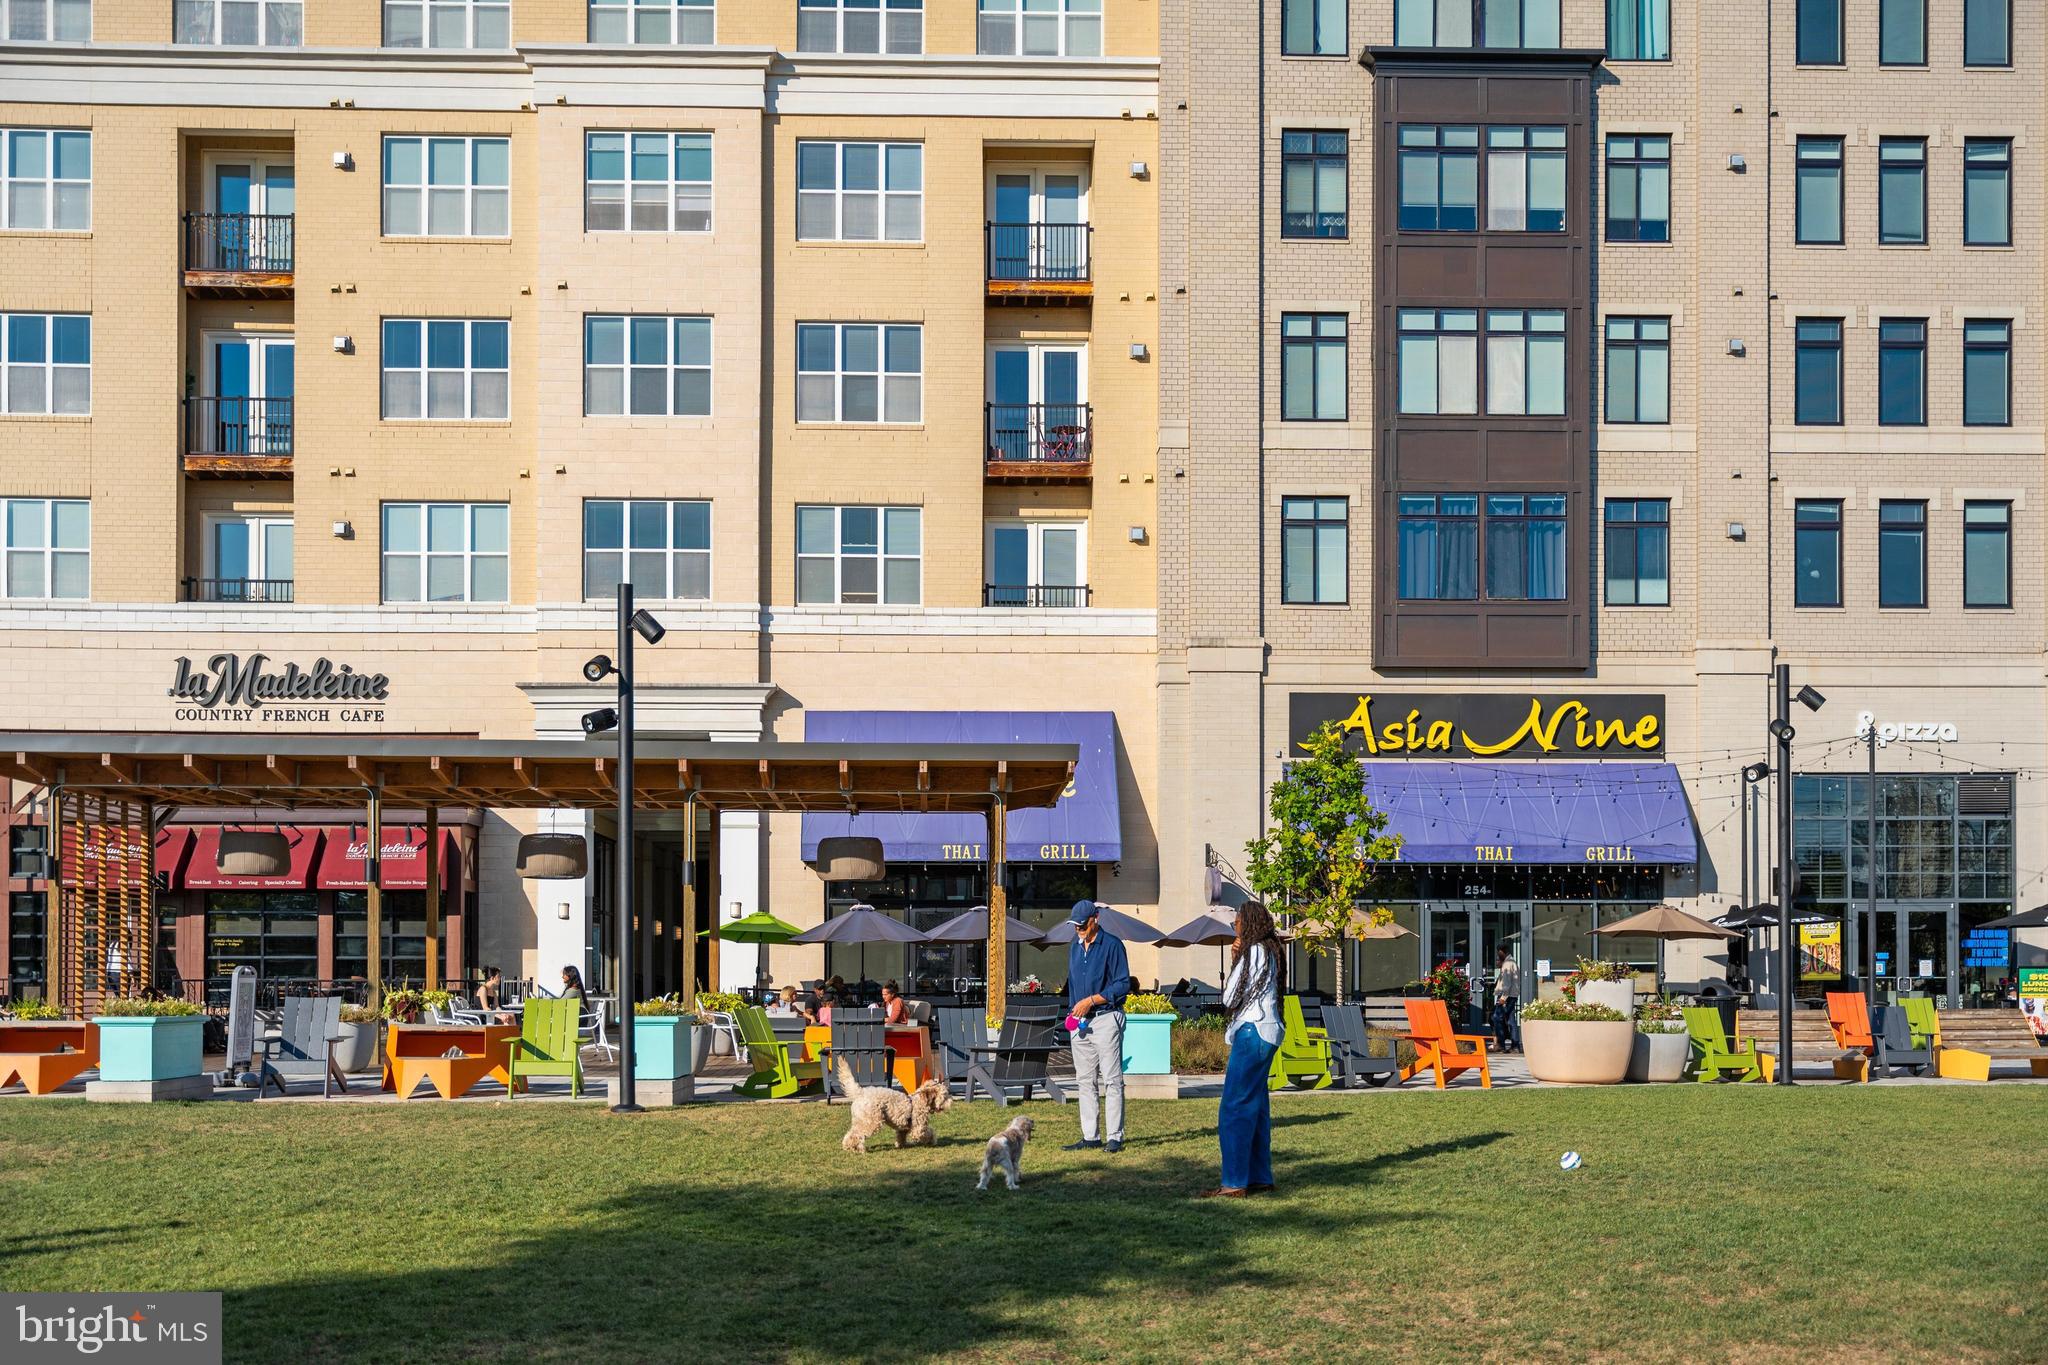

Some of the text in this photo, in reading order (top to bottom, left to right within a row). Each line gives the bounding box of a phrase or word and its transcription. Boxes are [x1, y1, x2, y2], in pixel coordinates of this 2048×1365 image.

[174, 652, 389, 708] la Madeleine
[175, 708, 385, 721] COUNTRY FRENCH CAFE
[1297, 695, 1661, 755] Asia Nine
[1856, 710, 1958, 748] &pizza
[942, 844, 981, 859] THAI
[1040, 844, 1090, 859] GRILL
[1475, 846, 1514, 861] THAI
[1586, 847, 1636, 861] GRILL
[1465, 885, 1487, 895] 254
